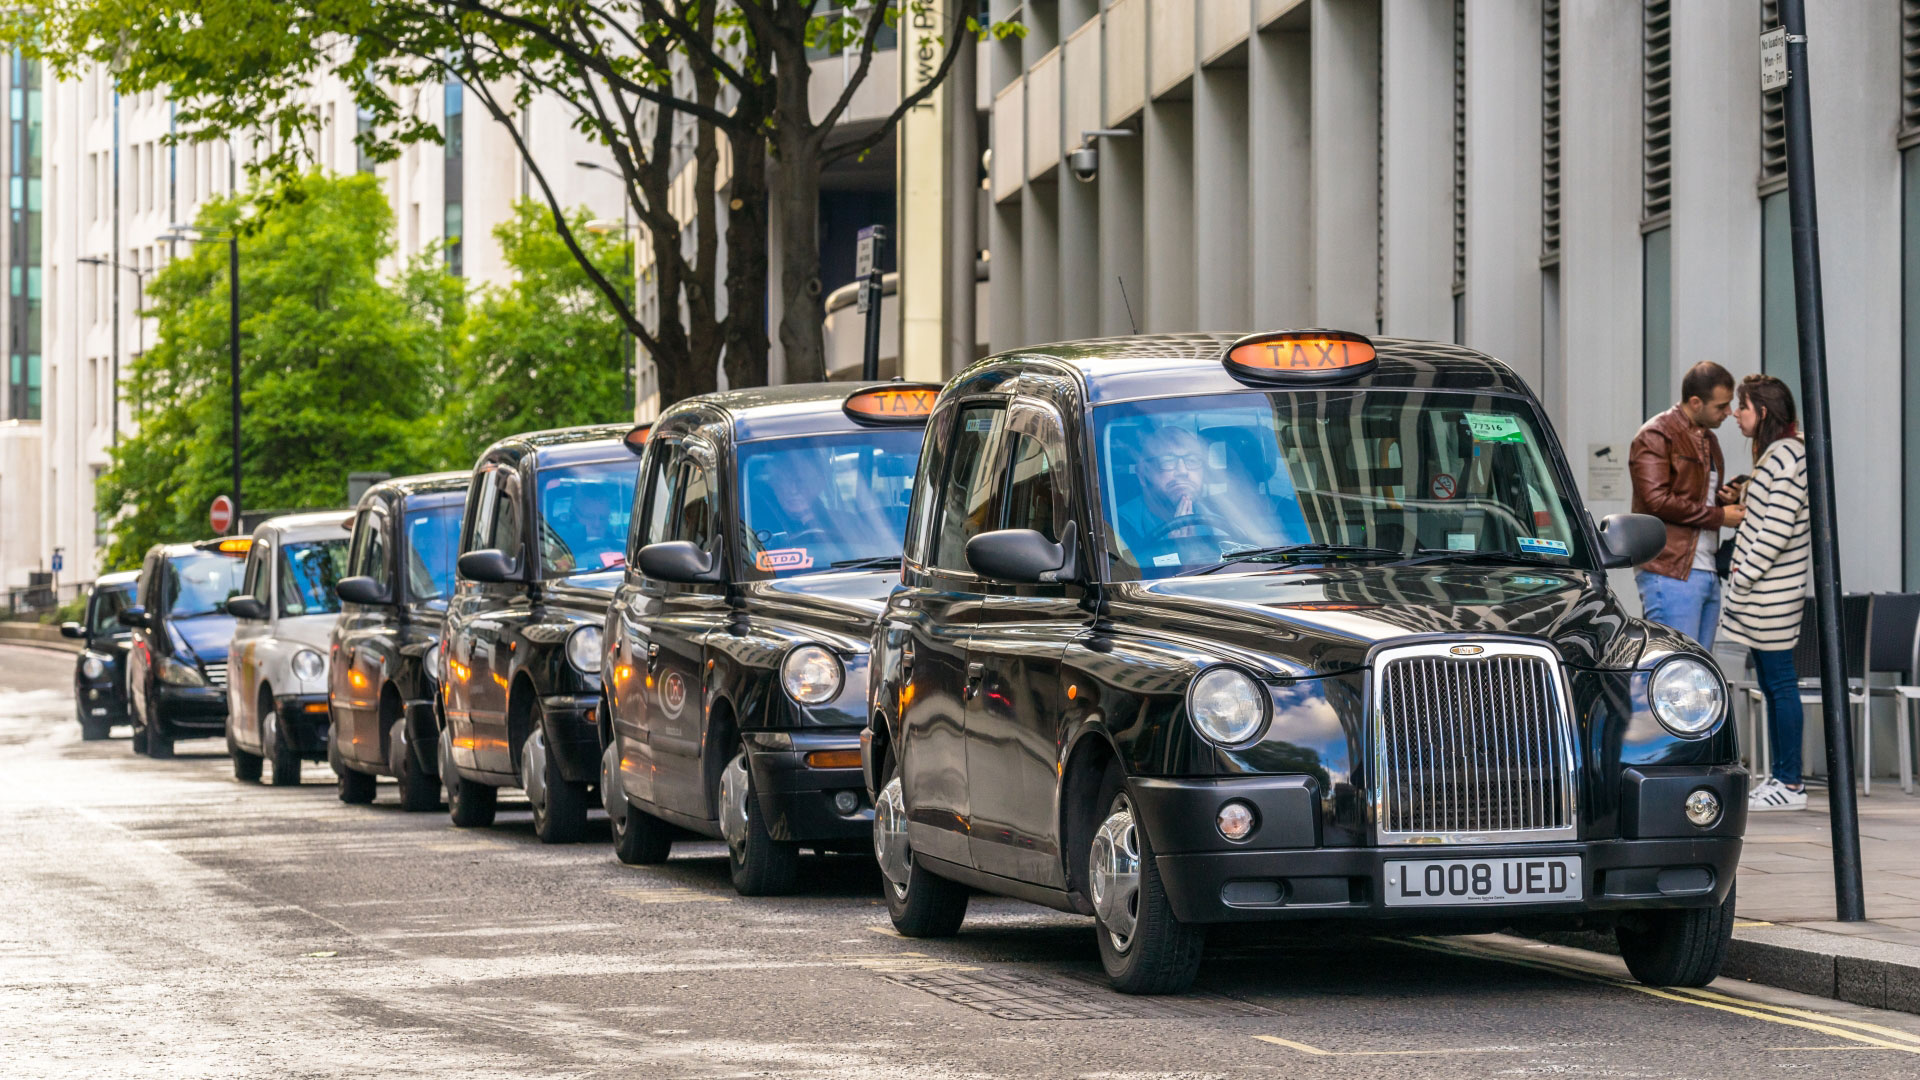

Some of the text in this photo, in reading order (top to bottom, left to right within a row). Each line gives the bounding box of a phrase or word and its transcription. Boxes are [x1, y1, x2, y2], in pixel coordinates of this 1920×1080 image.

[1761, 35, 1784, 51] No loading
[1266, 343, 1350, 367] TAXI
[1472, 422, 1503, 431] 77316
[1400, 861, 1567, 897] LO08 UED
